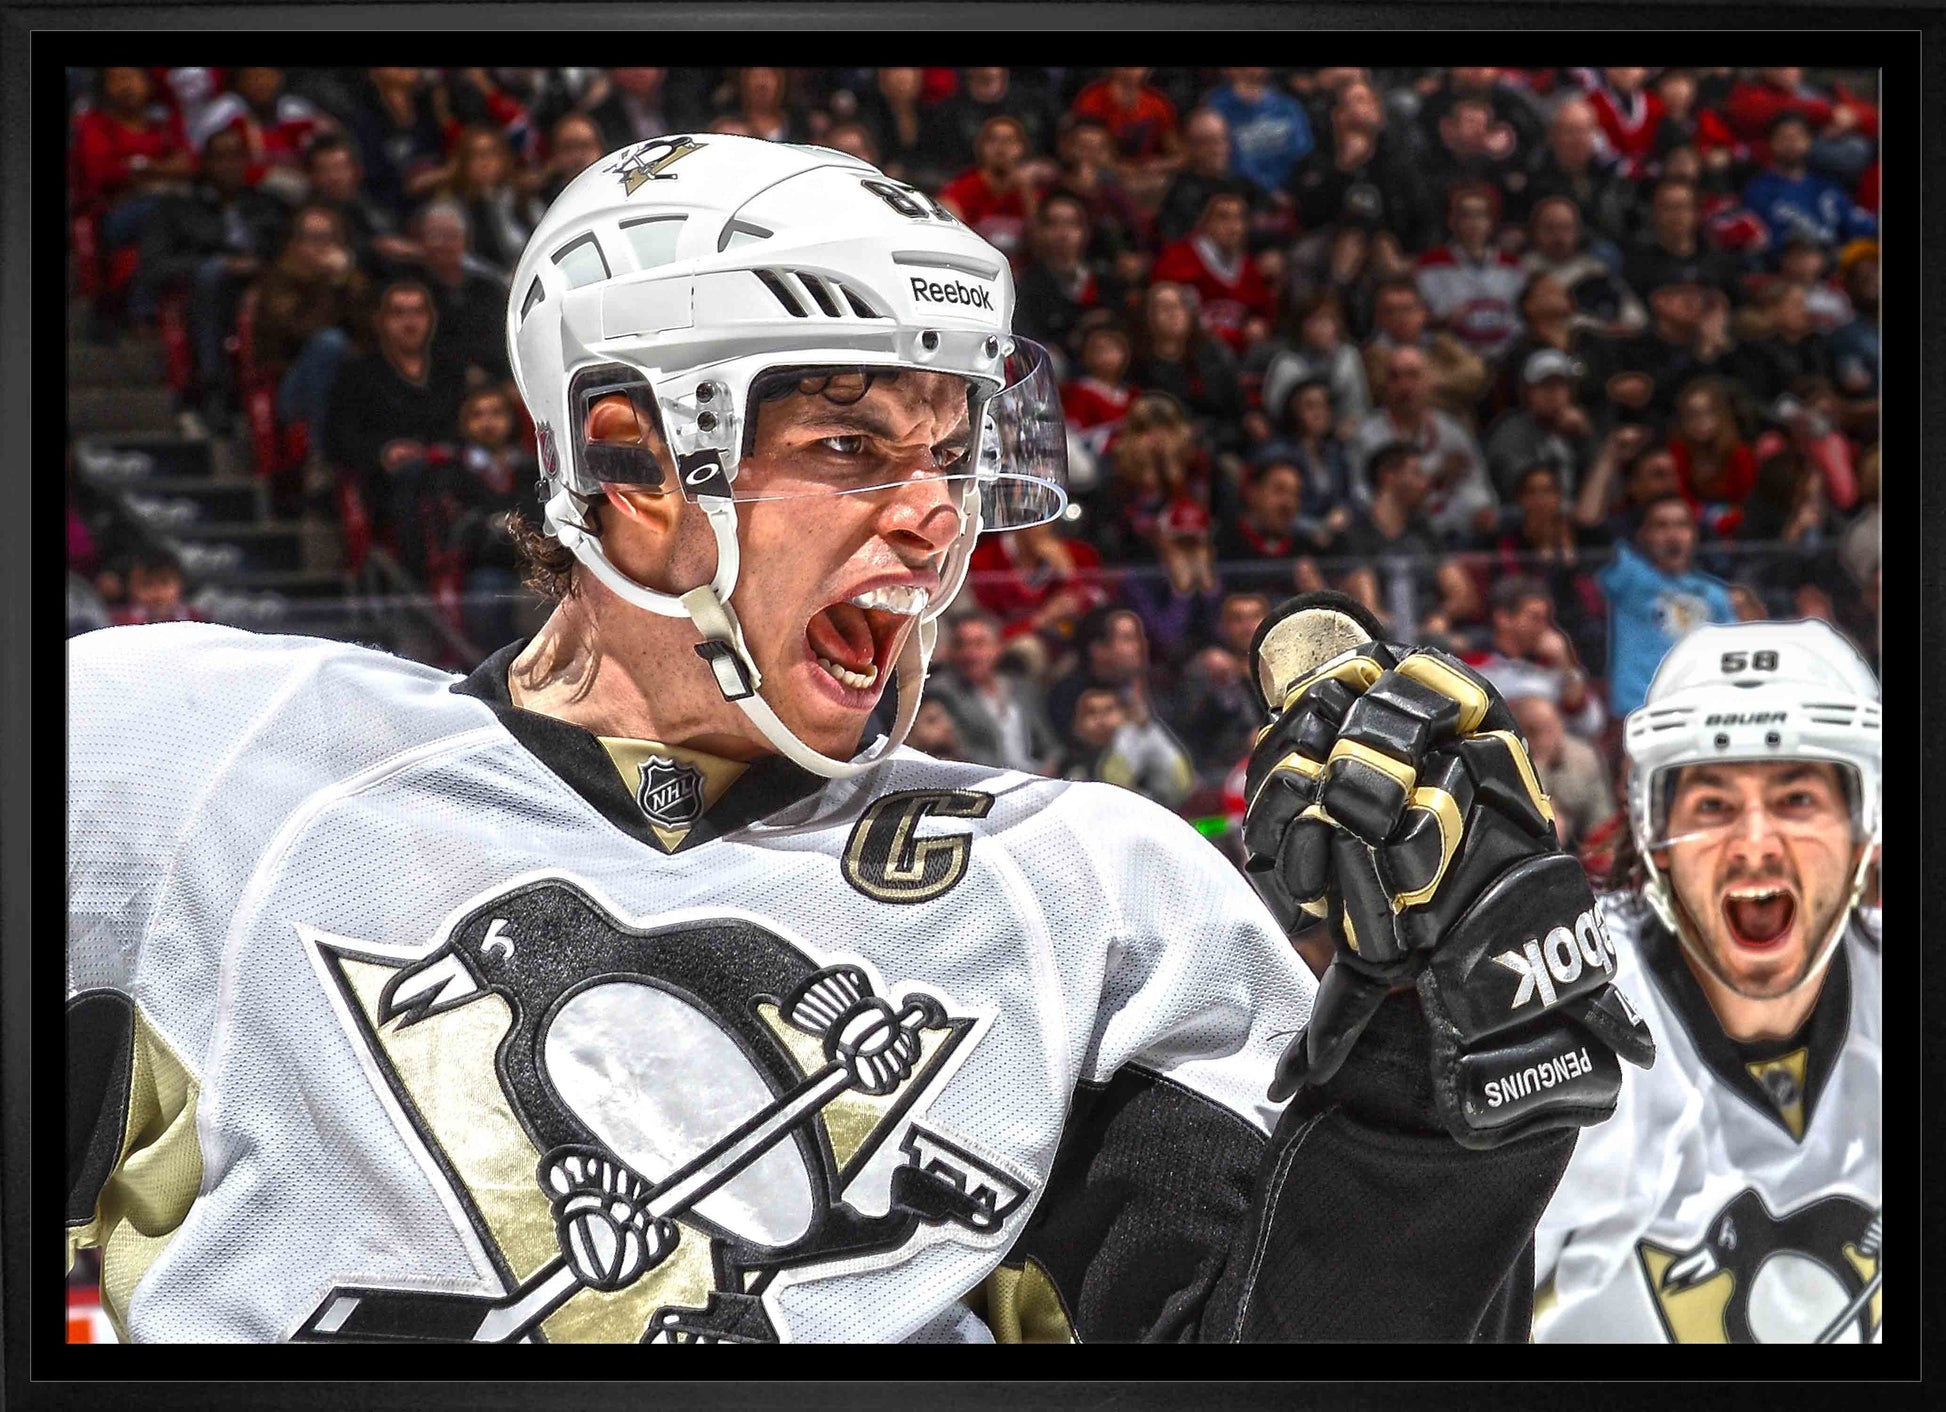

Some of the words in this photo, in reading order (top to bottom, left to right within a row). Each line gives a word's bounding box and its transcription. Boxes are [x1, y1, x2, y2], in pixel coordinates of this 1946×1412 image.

[910, 277, 994, 311] Reebok
[1721, 649, 1779, 674] 58
[652, 779, 693, 811] NHL
[840, 788, 996, 905] C
[1485, 1047, 1593, 1108] PENGUINS
